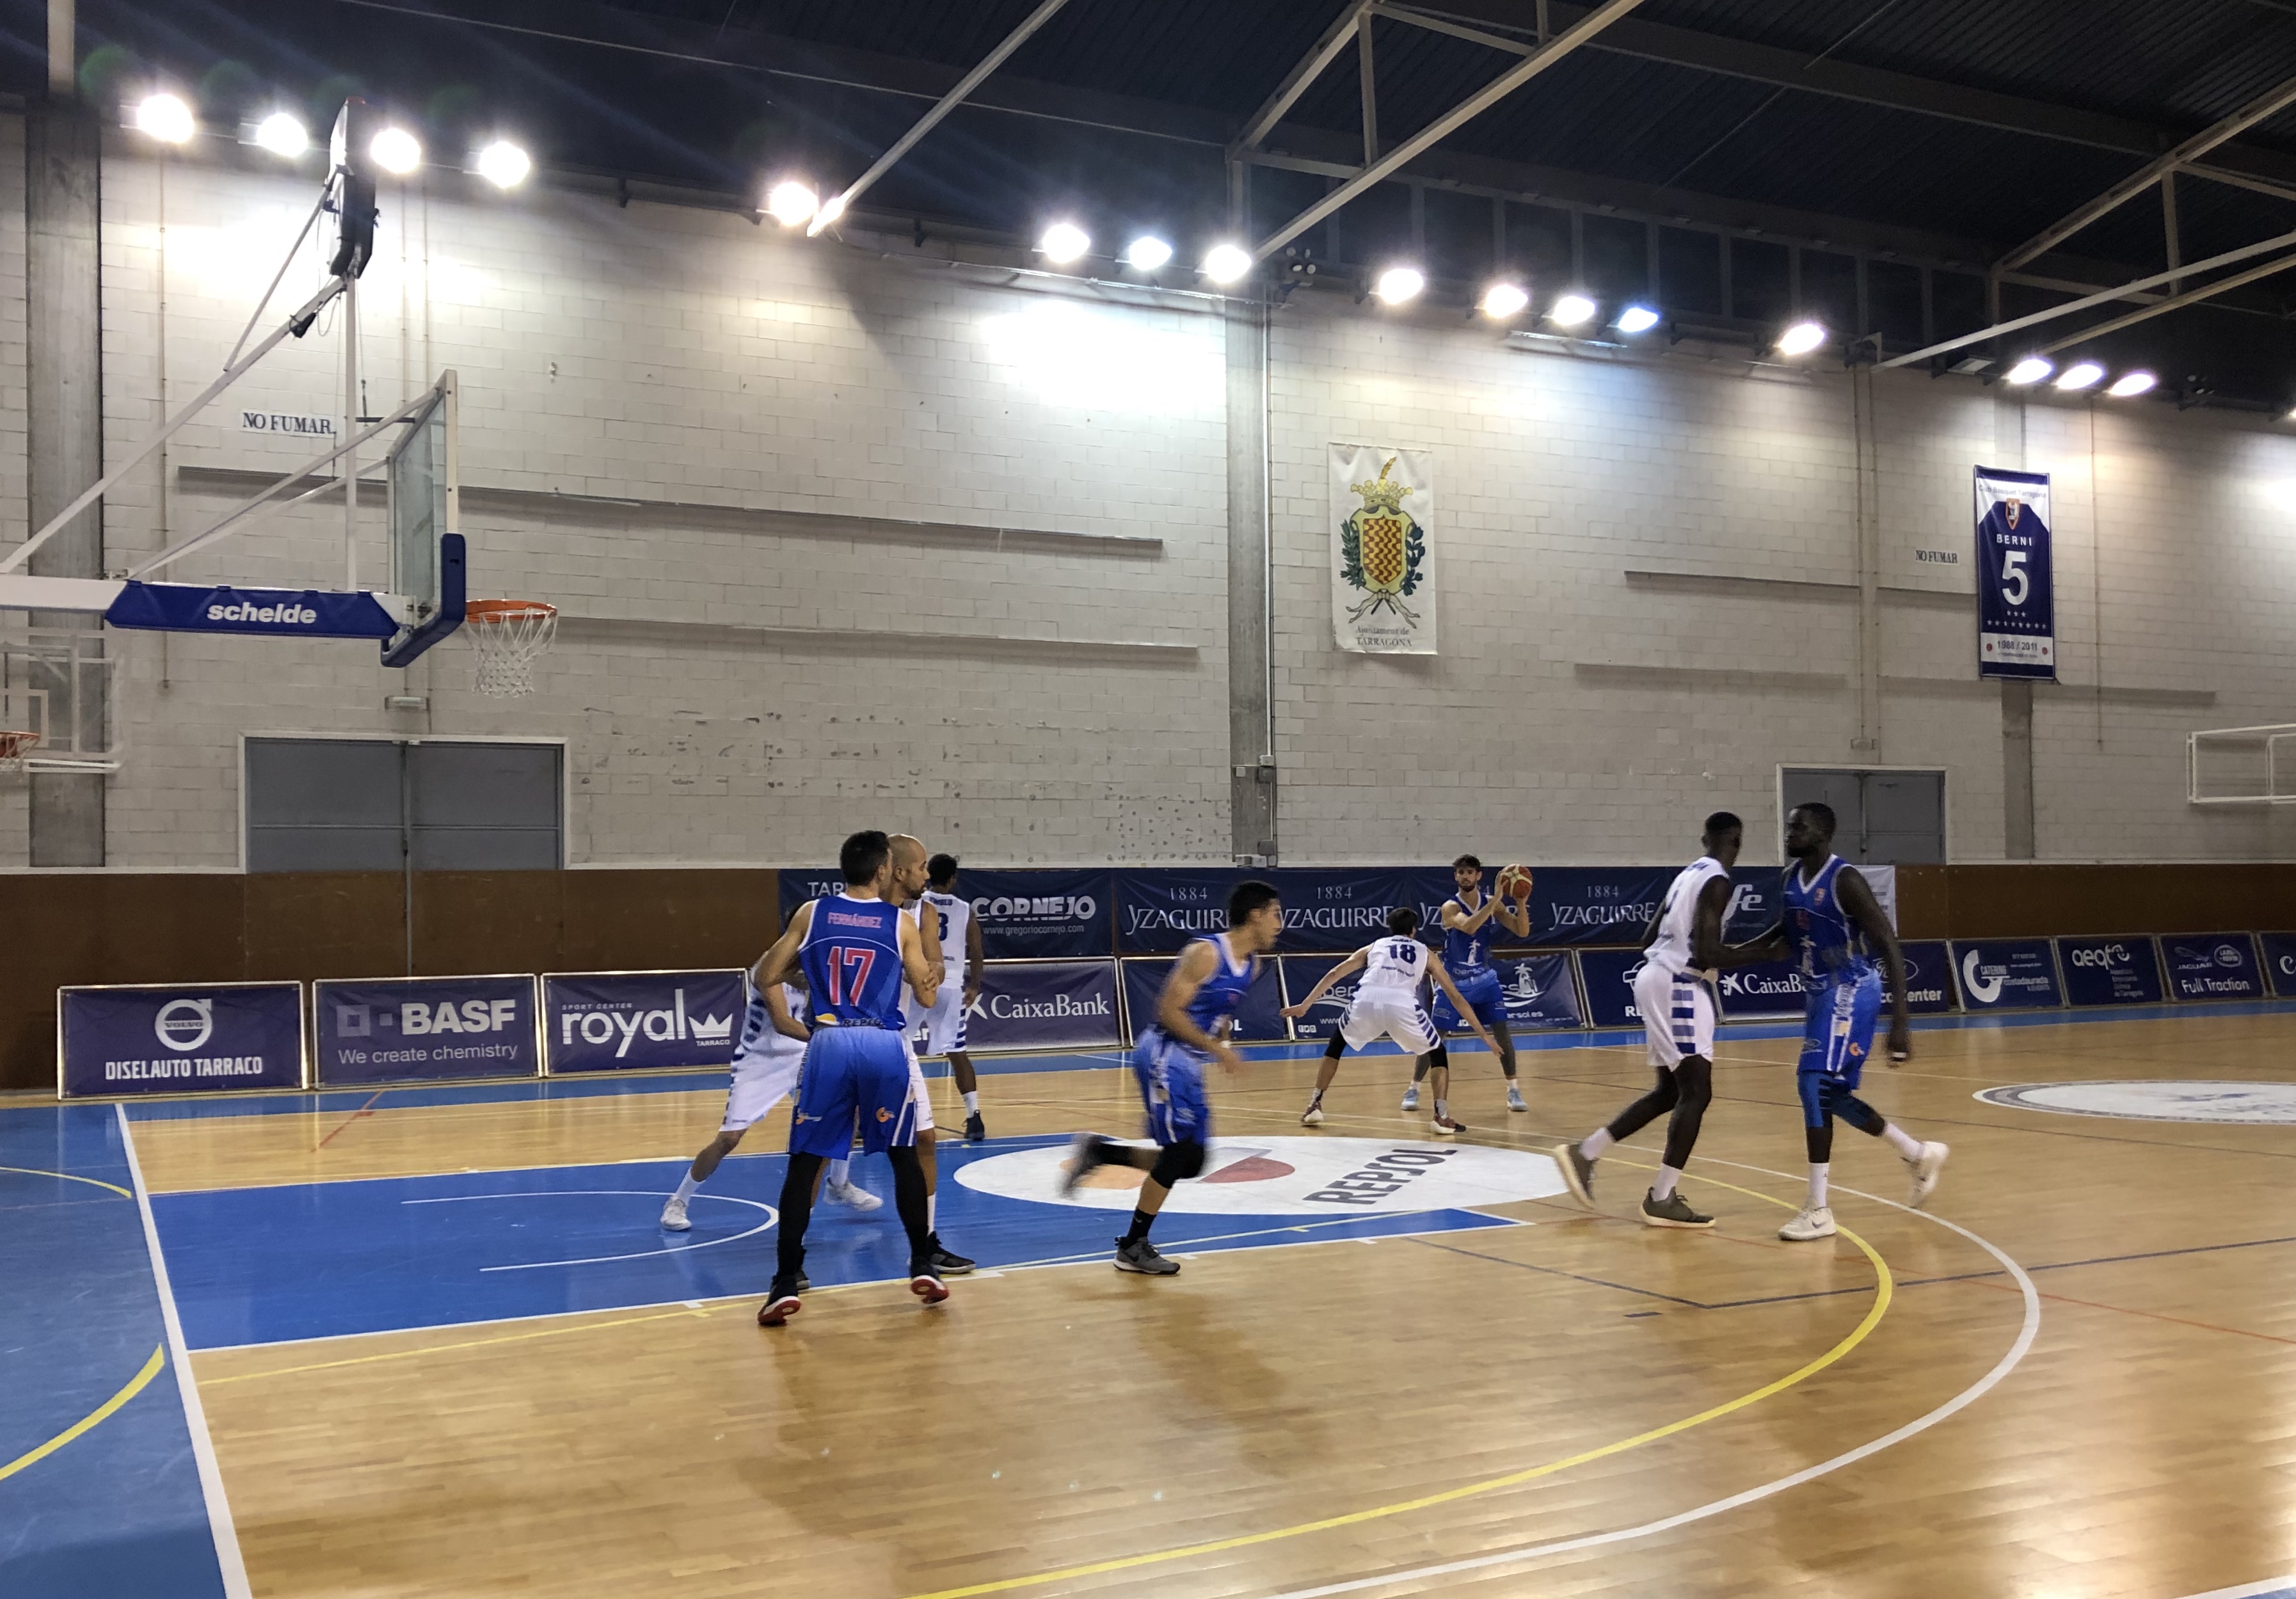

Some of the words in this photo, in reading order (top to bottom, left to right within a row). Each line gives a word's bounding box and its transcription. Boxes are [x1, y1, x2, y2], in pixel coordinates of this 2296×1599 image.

[243, 412, 266, 429] NO
[270, 415, 331, 434] FUMAR
[1997, 534, 2032, 546] BERNI
[1916, 550, 1927, 562] NO
[1928, 551, 1958, 564] FUMAR
[2002, 550, 2028, 605] 5
[207, 601, 317, 624] schelde
[1356, 626, 1399, 635] Ajuntament
[1357, 637, 1412, 647] TARRAGONA
[2021, 642, 2037, 651] 2011
[1170, 887, 1208, 900] 1884
[1317, 886, 1351, 899] 1884
[1587, 886, 1620, 898] 1884
[971, 896, 1096, 921] CORNEJO
[983, 925, 1084, 936] www.gregoriocornejo.com
[1385, 944, 1417, 965] 18
[827, 946, 876, 1007] 17
[1980, 965, 2007, 975] CATERING
[1744, 973, 1806, 994] CaixaB
[2181, 978, 2204, 993] Full
[2204, 978, 2250, 992] Traction
[1904, 989, 1941, 1003] enter
[991, 993, 1110, 1019] CaixaBank
[402, 999, 515, 1035] BASF
[562, 989, 686, 1058] royal
[339, 1049, 367, 1064] We
[372, 1047, 427, 1063] create
[433, 1044, 518, 1060] chemistry
[105, 1060, 191, 1080] DISELAUTO
[193, 1056, 262, 1076] TARRACO
